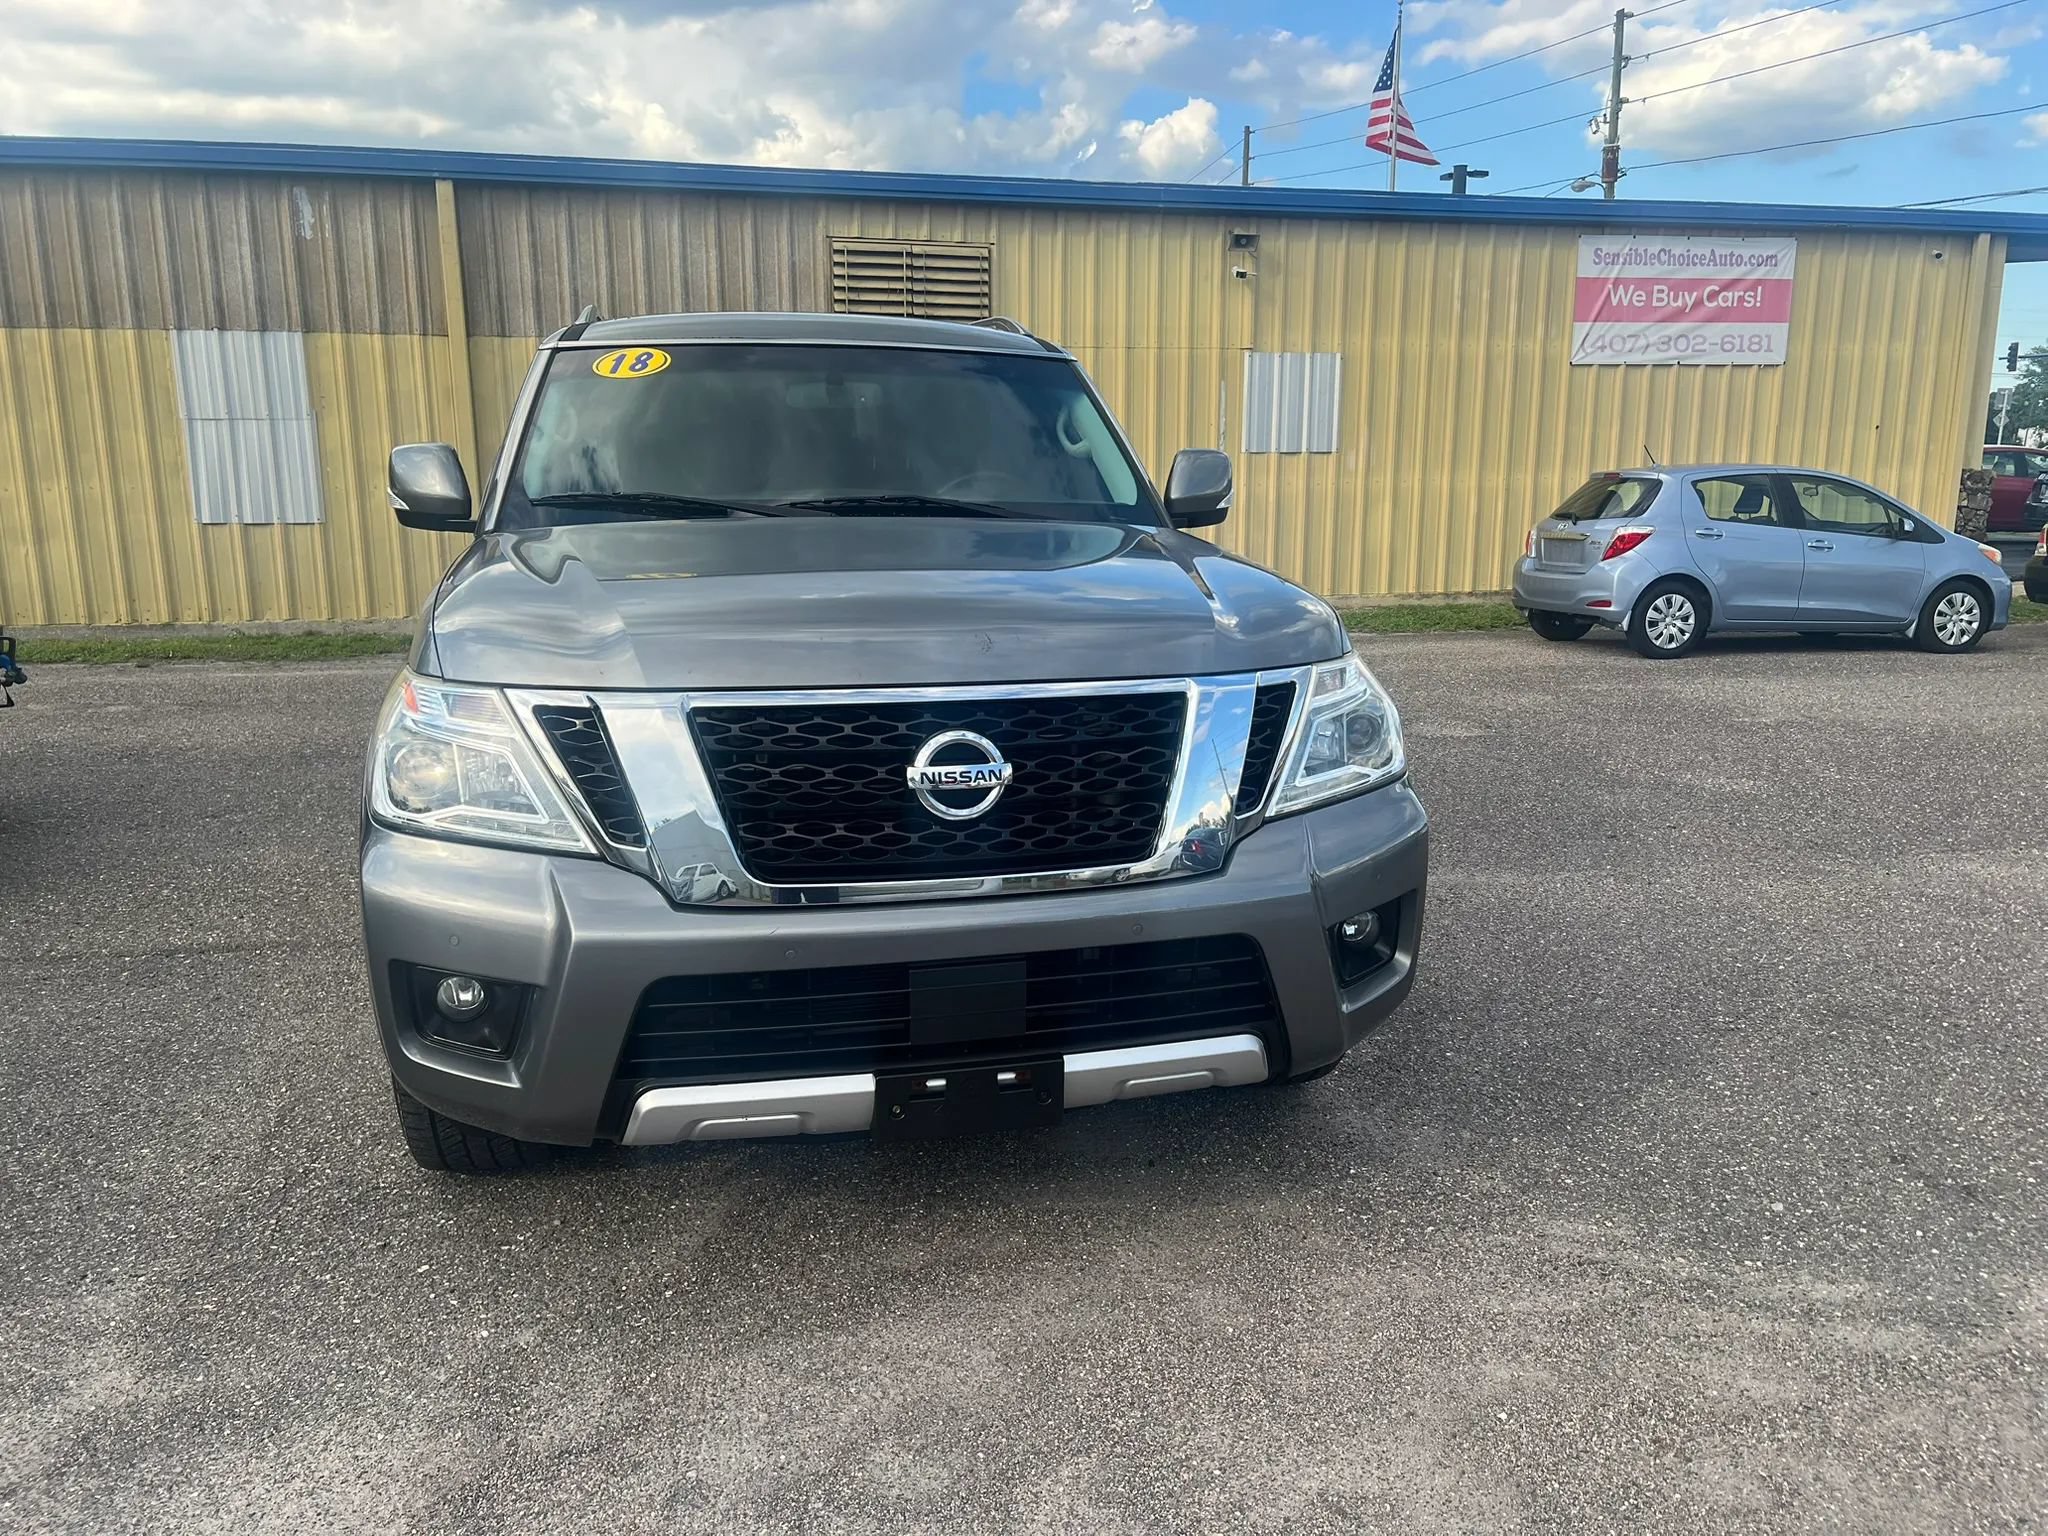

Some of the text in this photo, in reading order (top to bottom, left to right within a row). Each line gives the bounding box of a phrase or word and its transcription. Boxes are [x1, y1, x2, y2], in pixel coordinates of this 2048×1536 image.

[1592, 247, 1778, 268] SensibleChoiceAuto.com
[1608, 284, 1762, 312] We Buy Cars!
[609, 351, 654, 375] 18
[920, 768, 1003, 785] NISSAN
